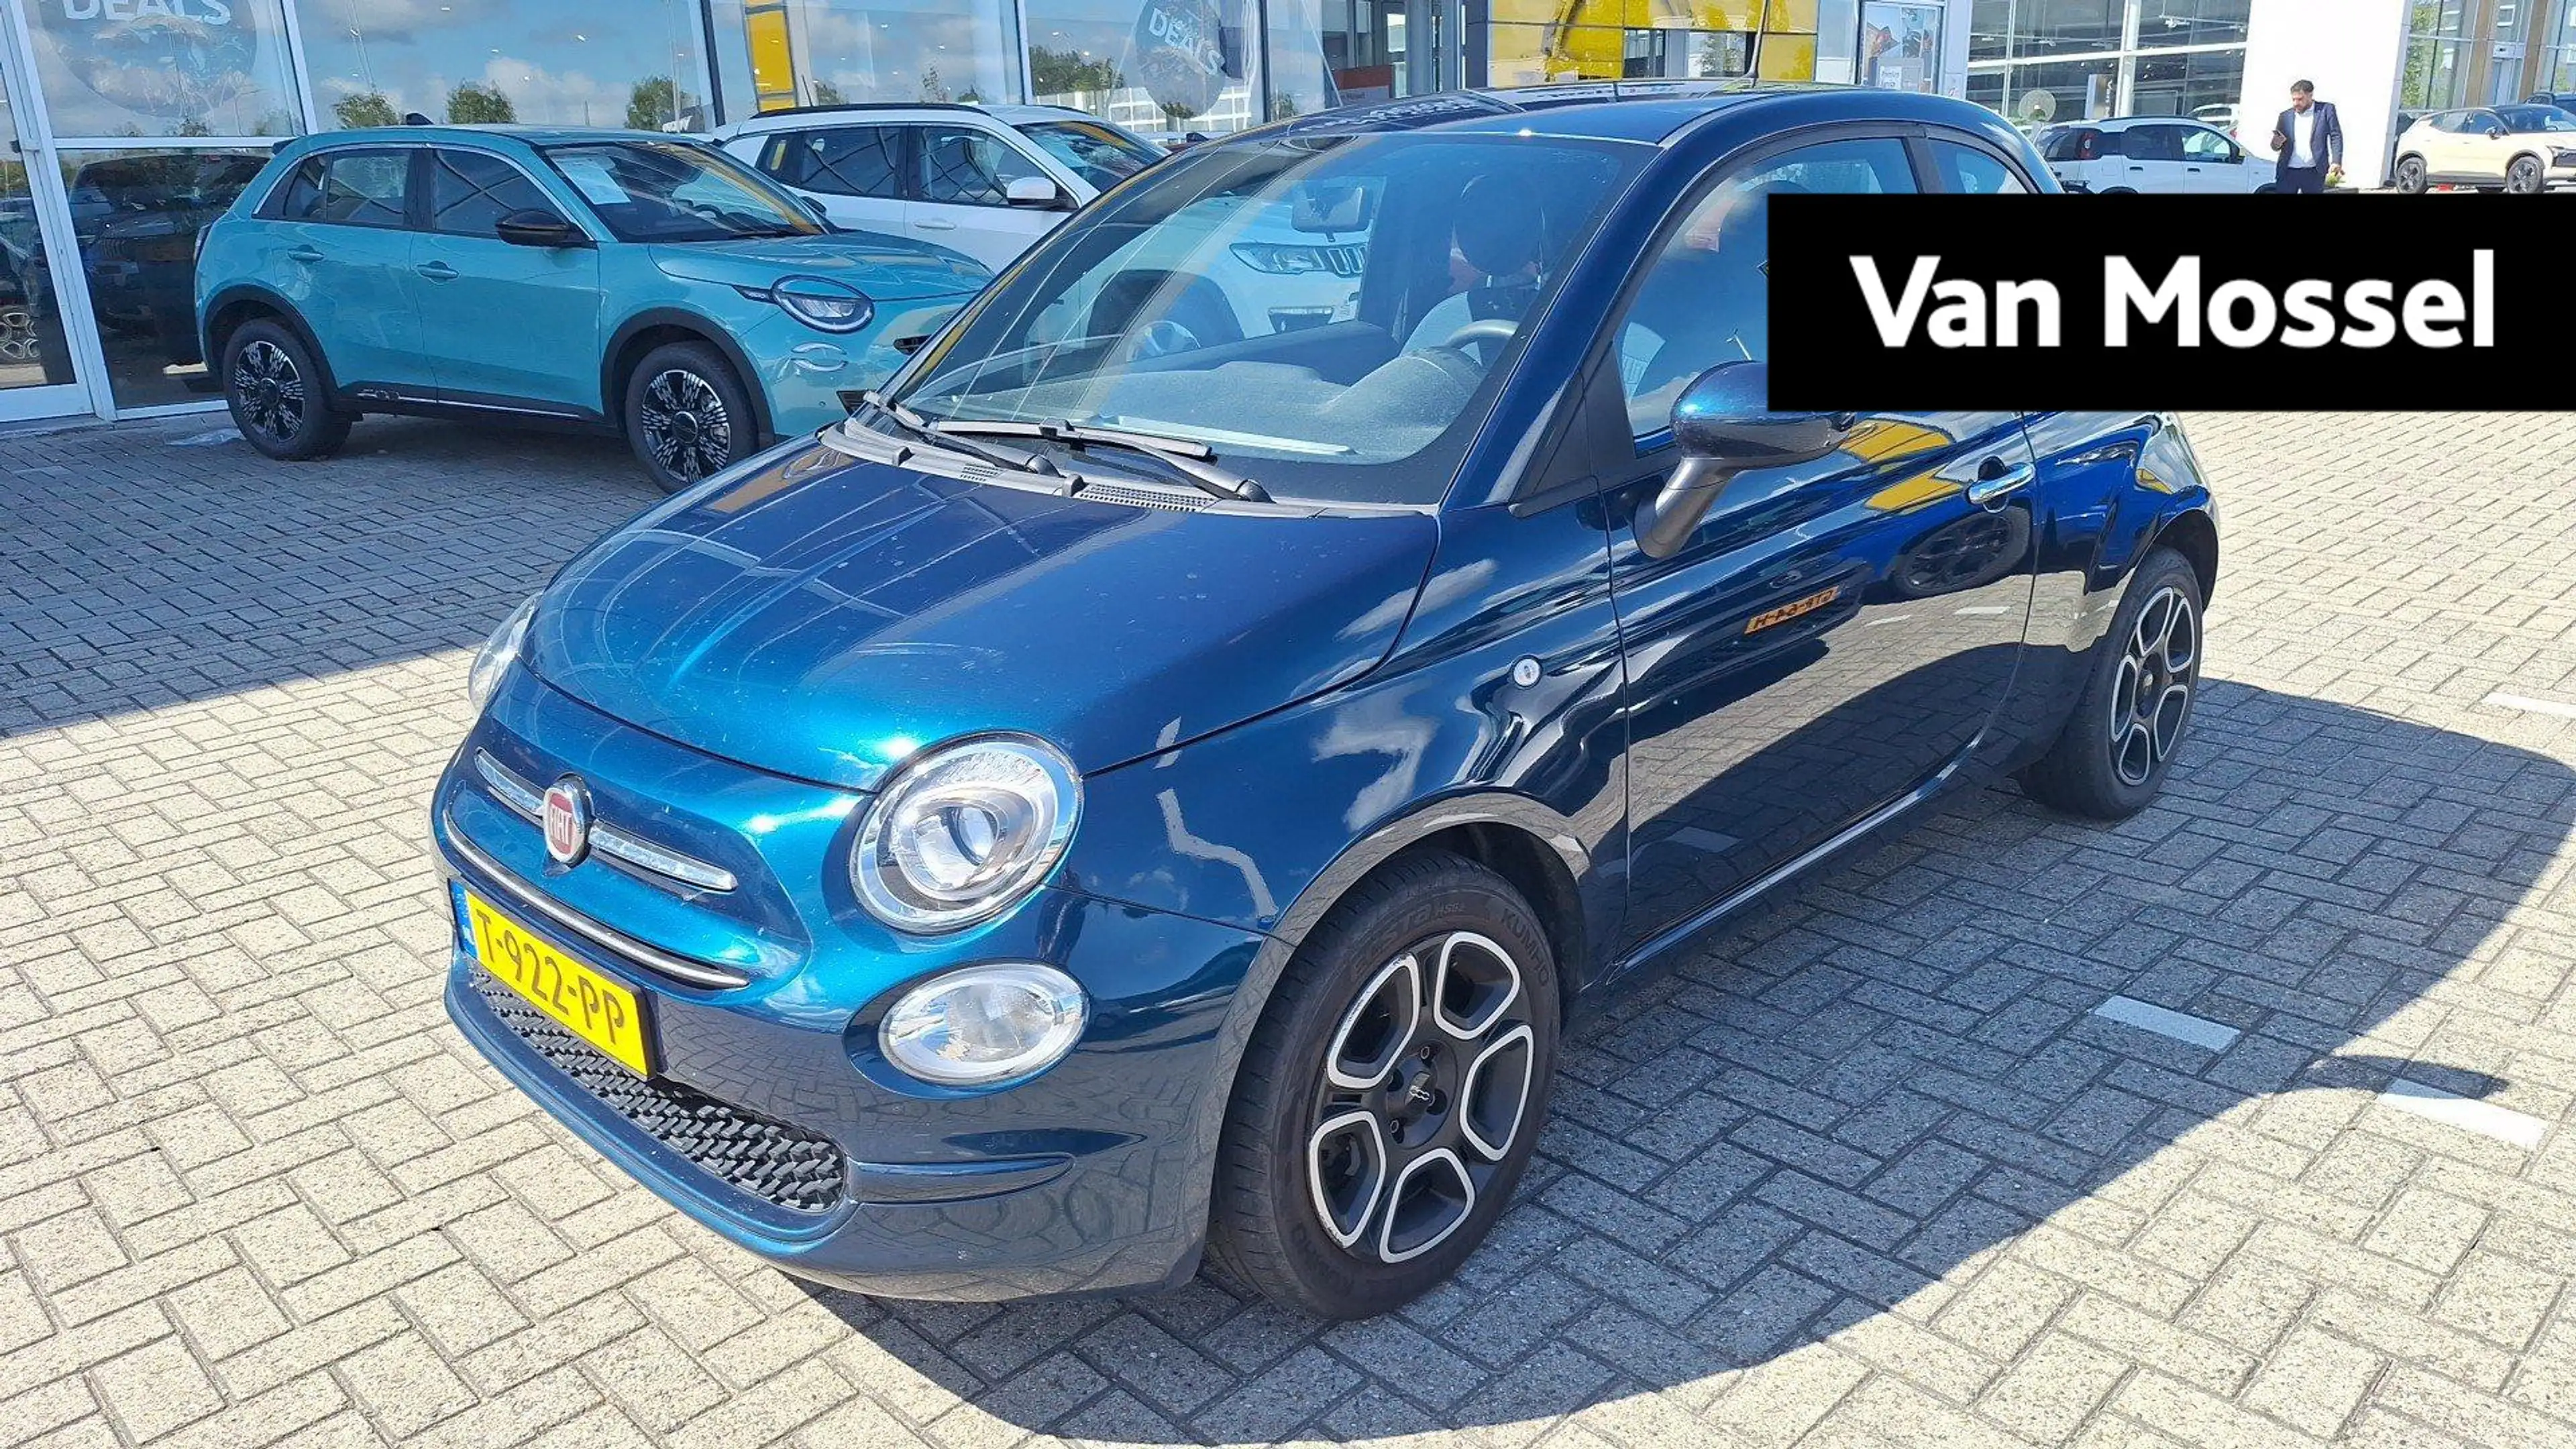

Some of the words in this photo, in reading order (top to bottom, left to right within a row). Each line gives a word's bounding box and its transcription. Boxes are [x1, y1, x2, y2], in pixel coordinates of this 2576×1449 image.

[1148, 7, 1226, 76] DEALS
[550, 803, 573, 846] FIAT
[476, 908, 625, 1045] T-922-PP
